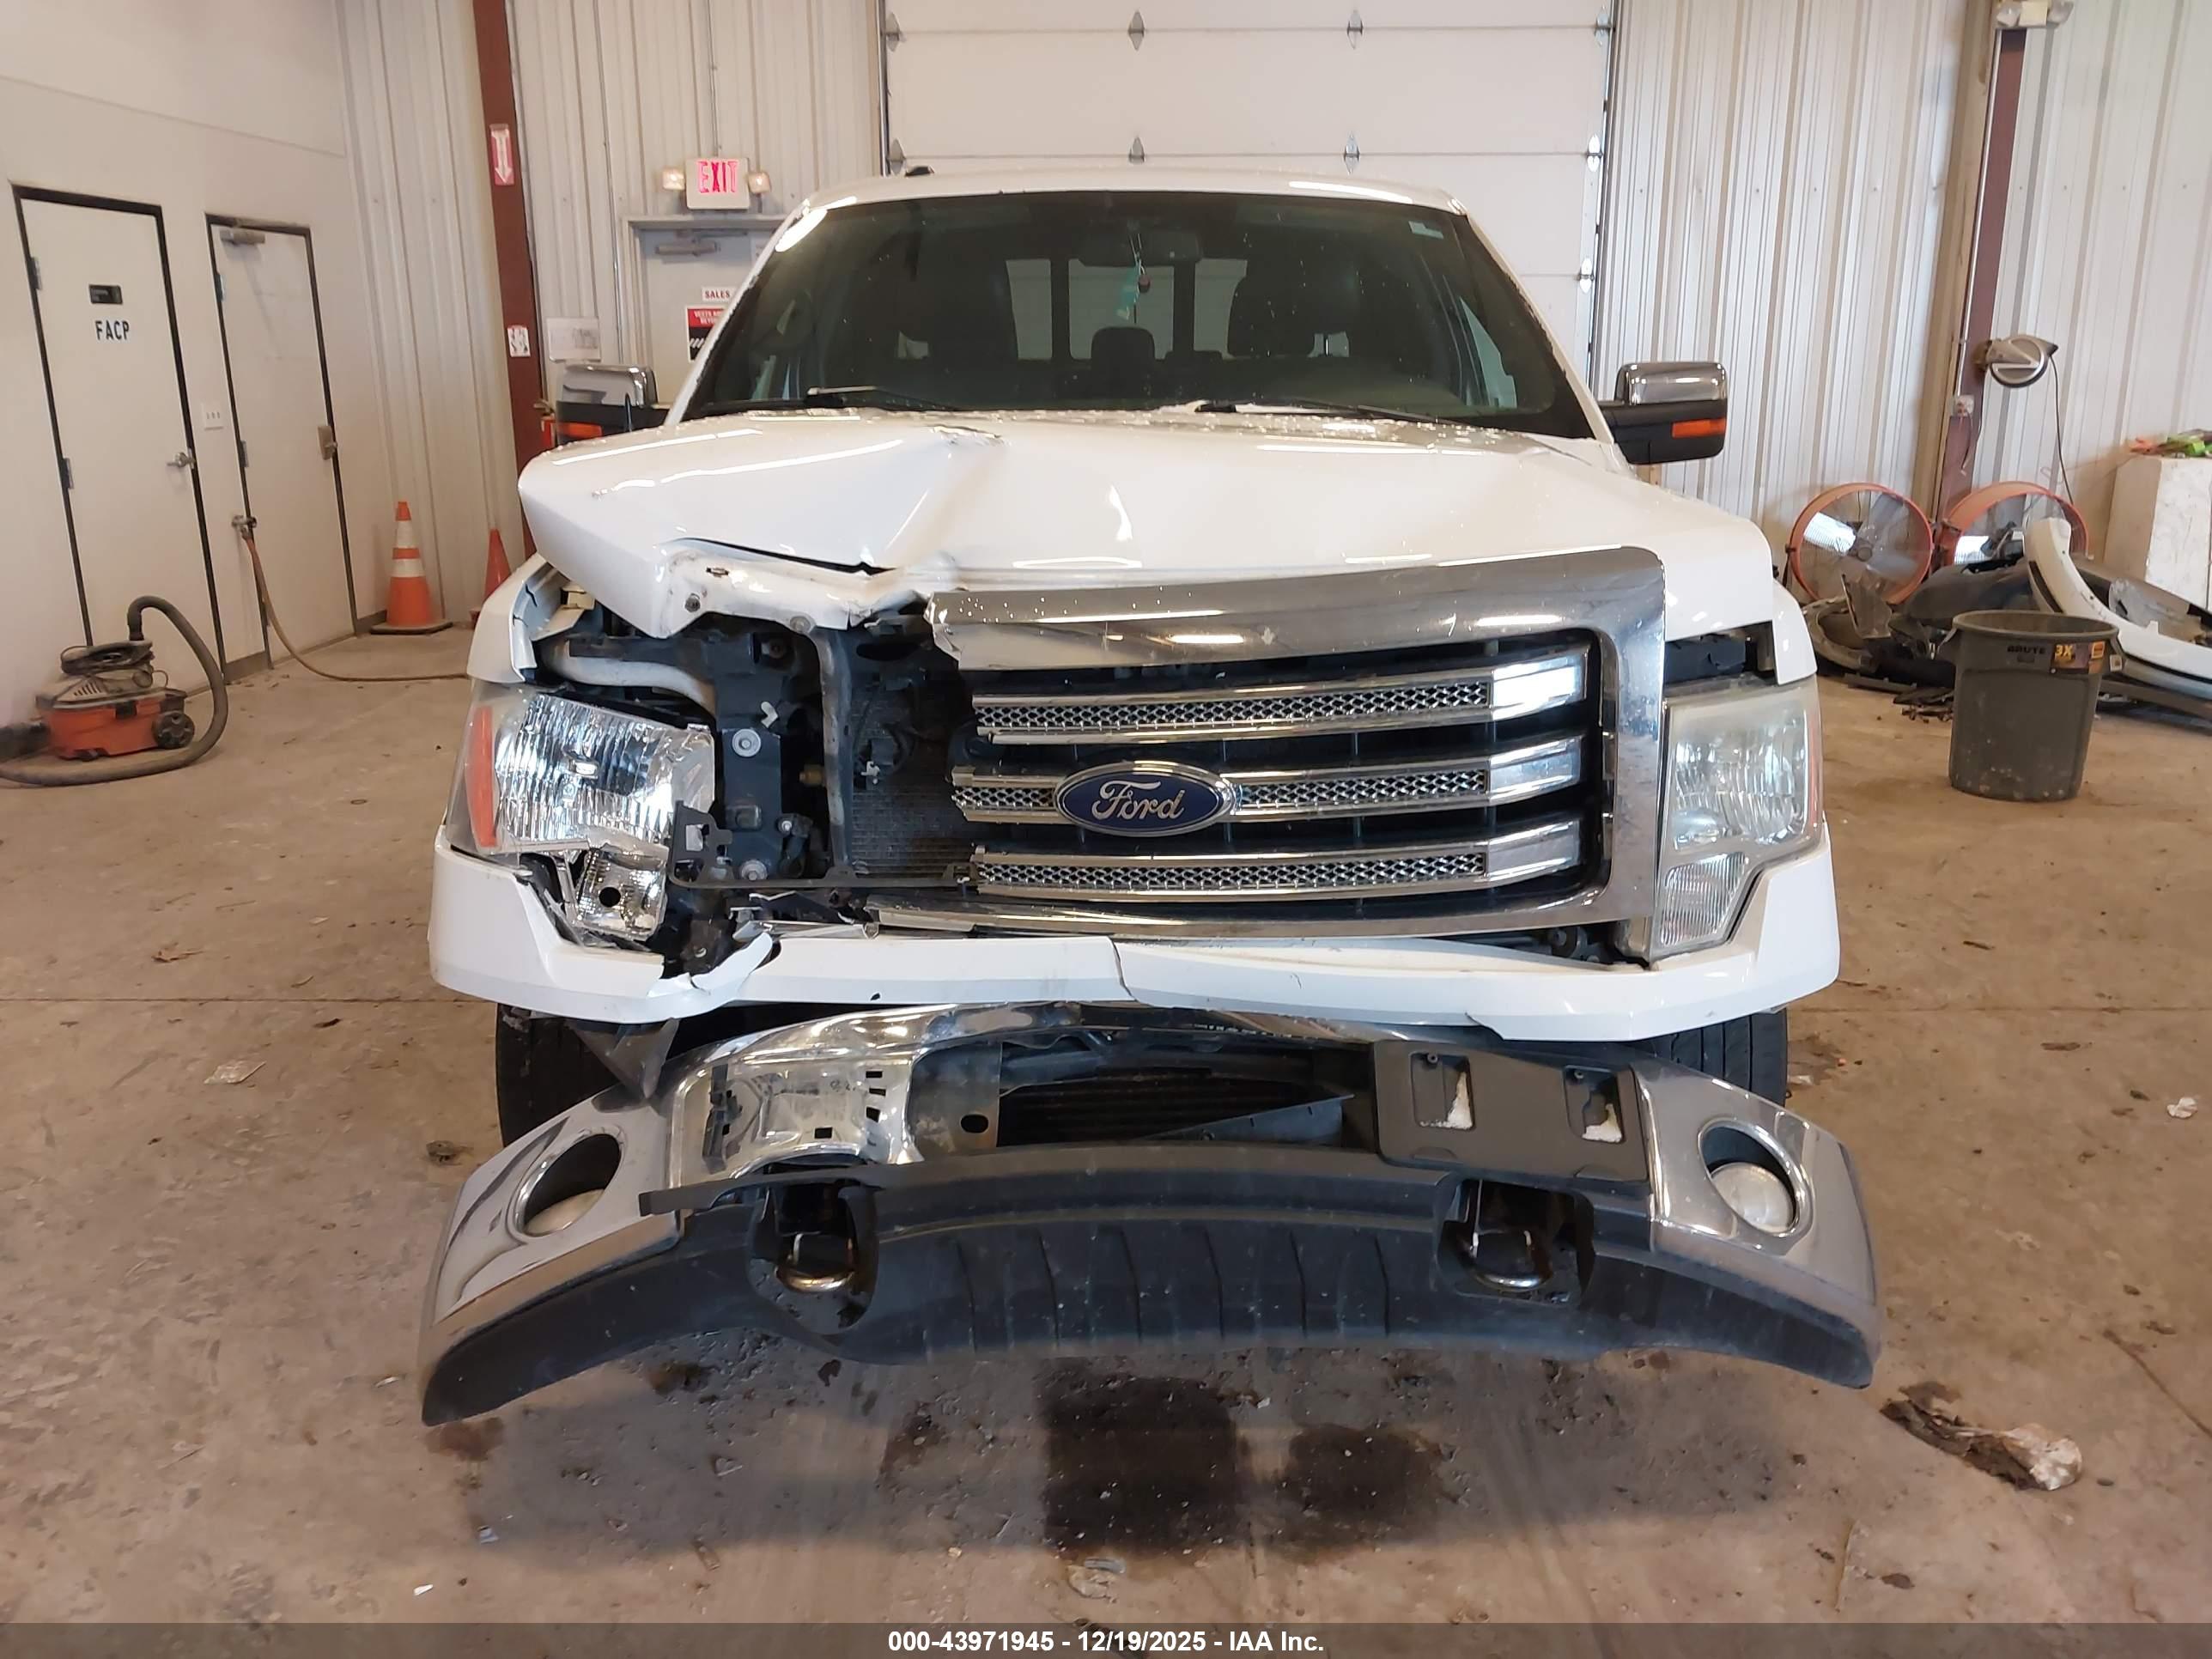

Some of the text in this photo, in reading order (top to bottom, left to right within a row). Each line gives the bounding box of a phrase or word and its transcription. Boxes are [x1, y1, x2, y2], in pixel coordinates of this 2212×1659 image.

[698, 161, 738, 193] EXIT
[704, 290, 731, 300] SALES
[94, 319, 130, 340] FACP
[2054, 644, 2073, 660] 3X
[1091, 780, 1186, 820] Ford
